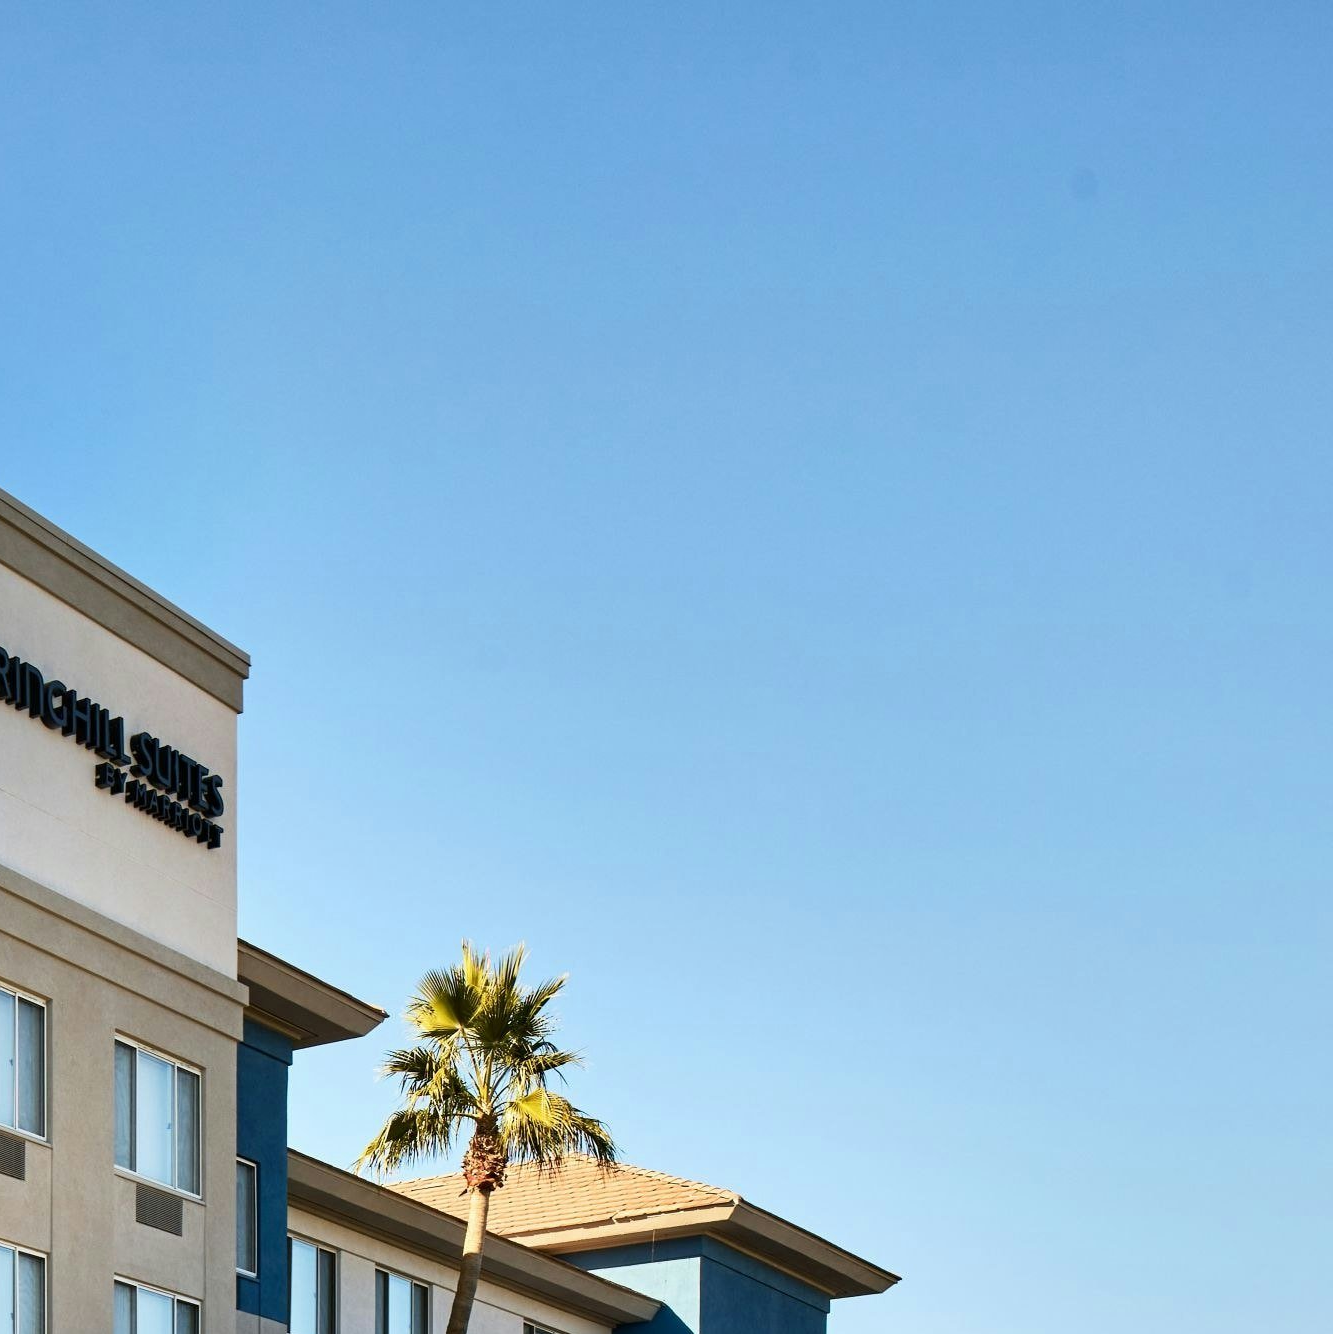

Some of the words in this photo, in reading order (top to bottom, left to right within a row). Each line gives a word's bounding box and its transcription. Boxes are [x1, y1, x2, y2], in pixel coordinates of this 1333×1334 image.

[95, 762, 128, 795] BY
[125, 780, 225, 850] MARRIOTT
[129, 732, 225, 818] SUITES
